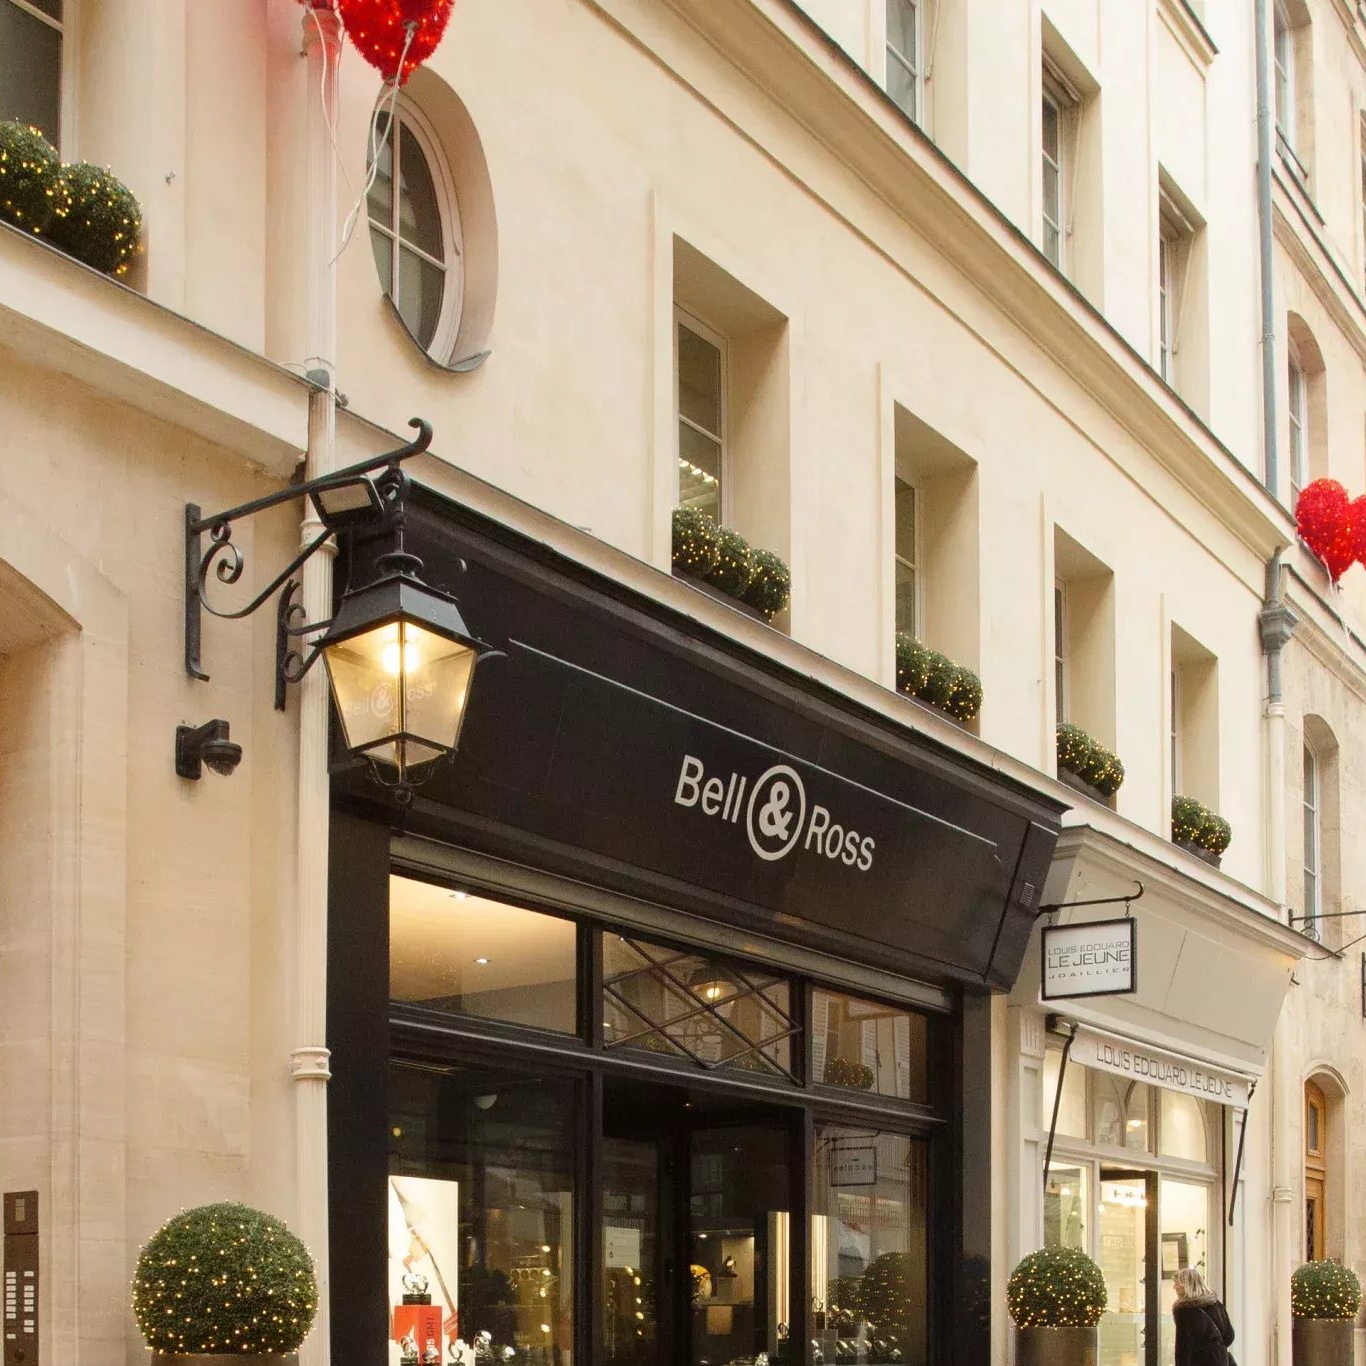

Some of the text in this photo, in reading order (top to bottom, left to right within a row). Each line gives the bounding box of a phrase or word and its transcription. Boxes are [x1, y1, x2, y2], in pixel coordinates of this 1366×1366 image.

[674, 754, 747, 824] Bell
[804, 804, 876, 871] Ross
[1048, 940, 1130, 956] LOUIS EDOUARD
[1048, 949, 1130, 969] LE JEUNE
[1048, 966, 1130, 980] JOAILLIER
[1096, 1041, 1232, 1099] LOUIS EDOUARD LE JEUNE
